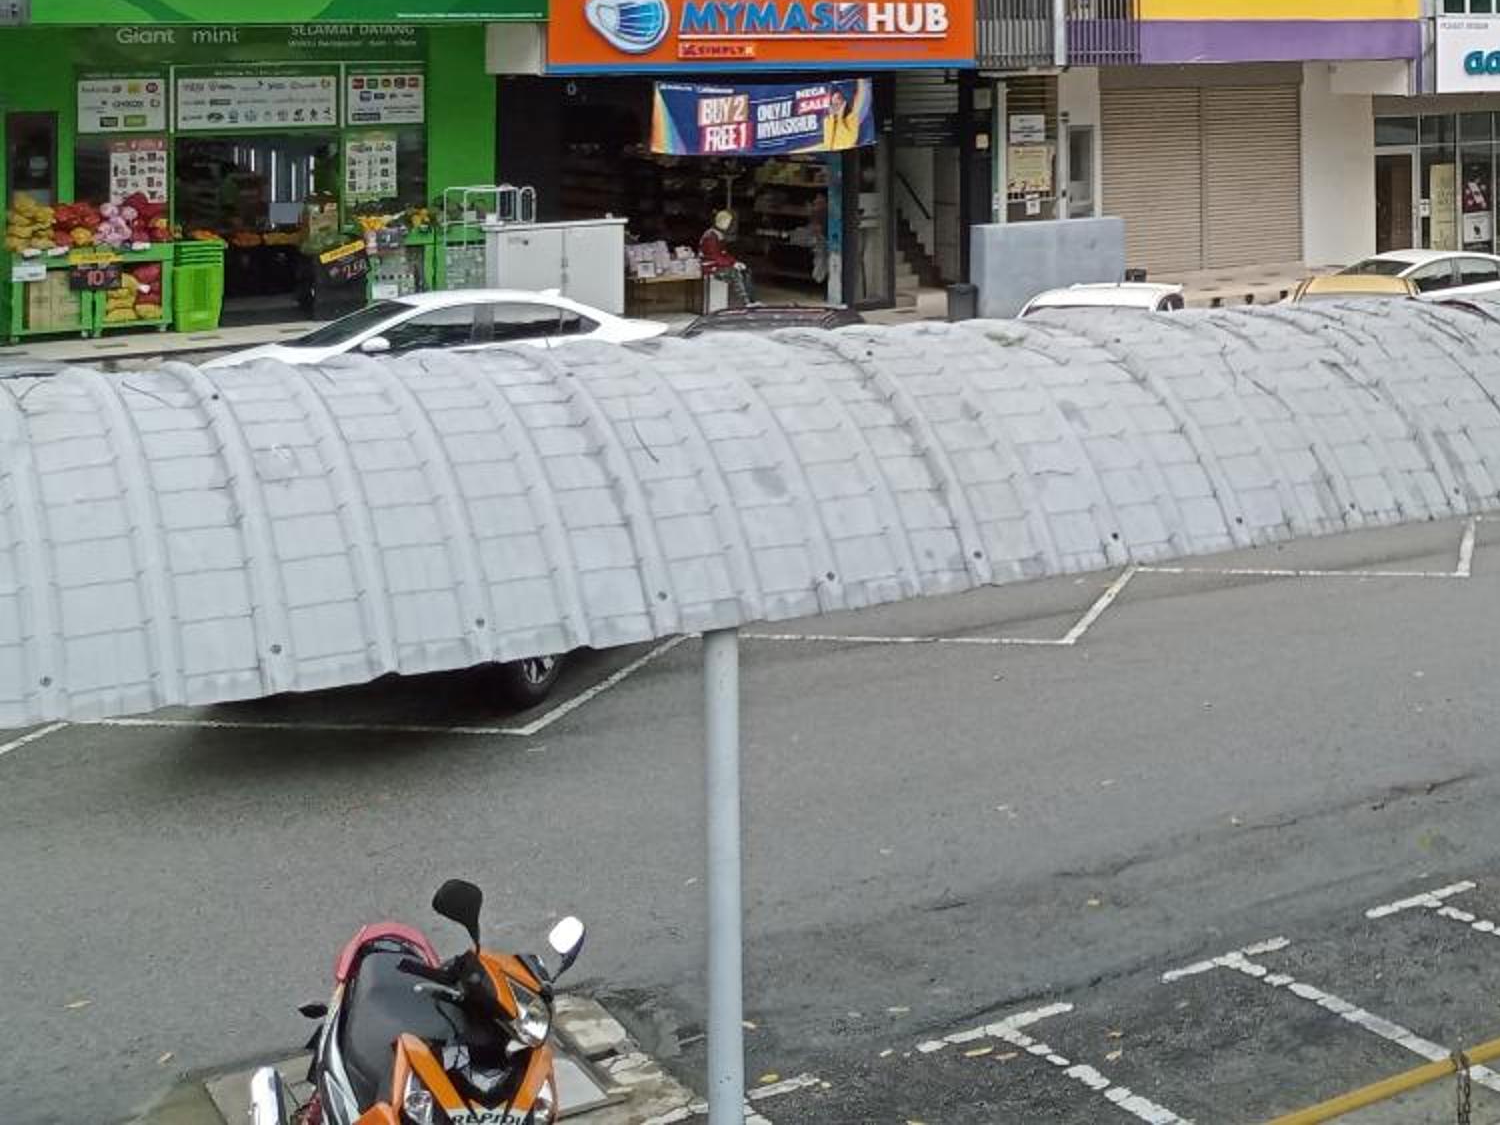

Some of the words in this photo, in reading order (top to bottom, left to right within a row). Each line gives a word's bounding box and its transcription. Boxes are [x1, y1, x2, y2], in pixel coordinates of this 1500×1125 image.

[116, 26, 175, 44] Giant
[192, 26, 239, 44] mini
[703, 98, 732, 124] BUY
[733, 96, 745, 122] 2
[757, 102, 780, 122] ONLY
[781, 100, 792, 118] AT
[704, 124, 738, 152] FREE
[739, 123, 747, 148] 1
